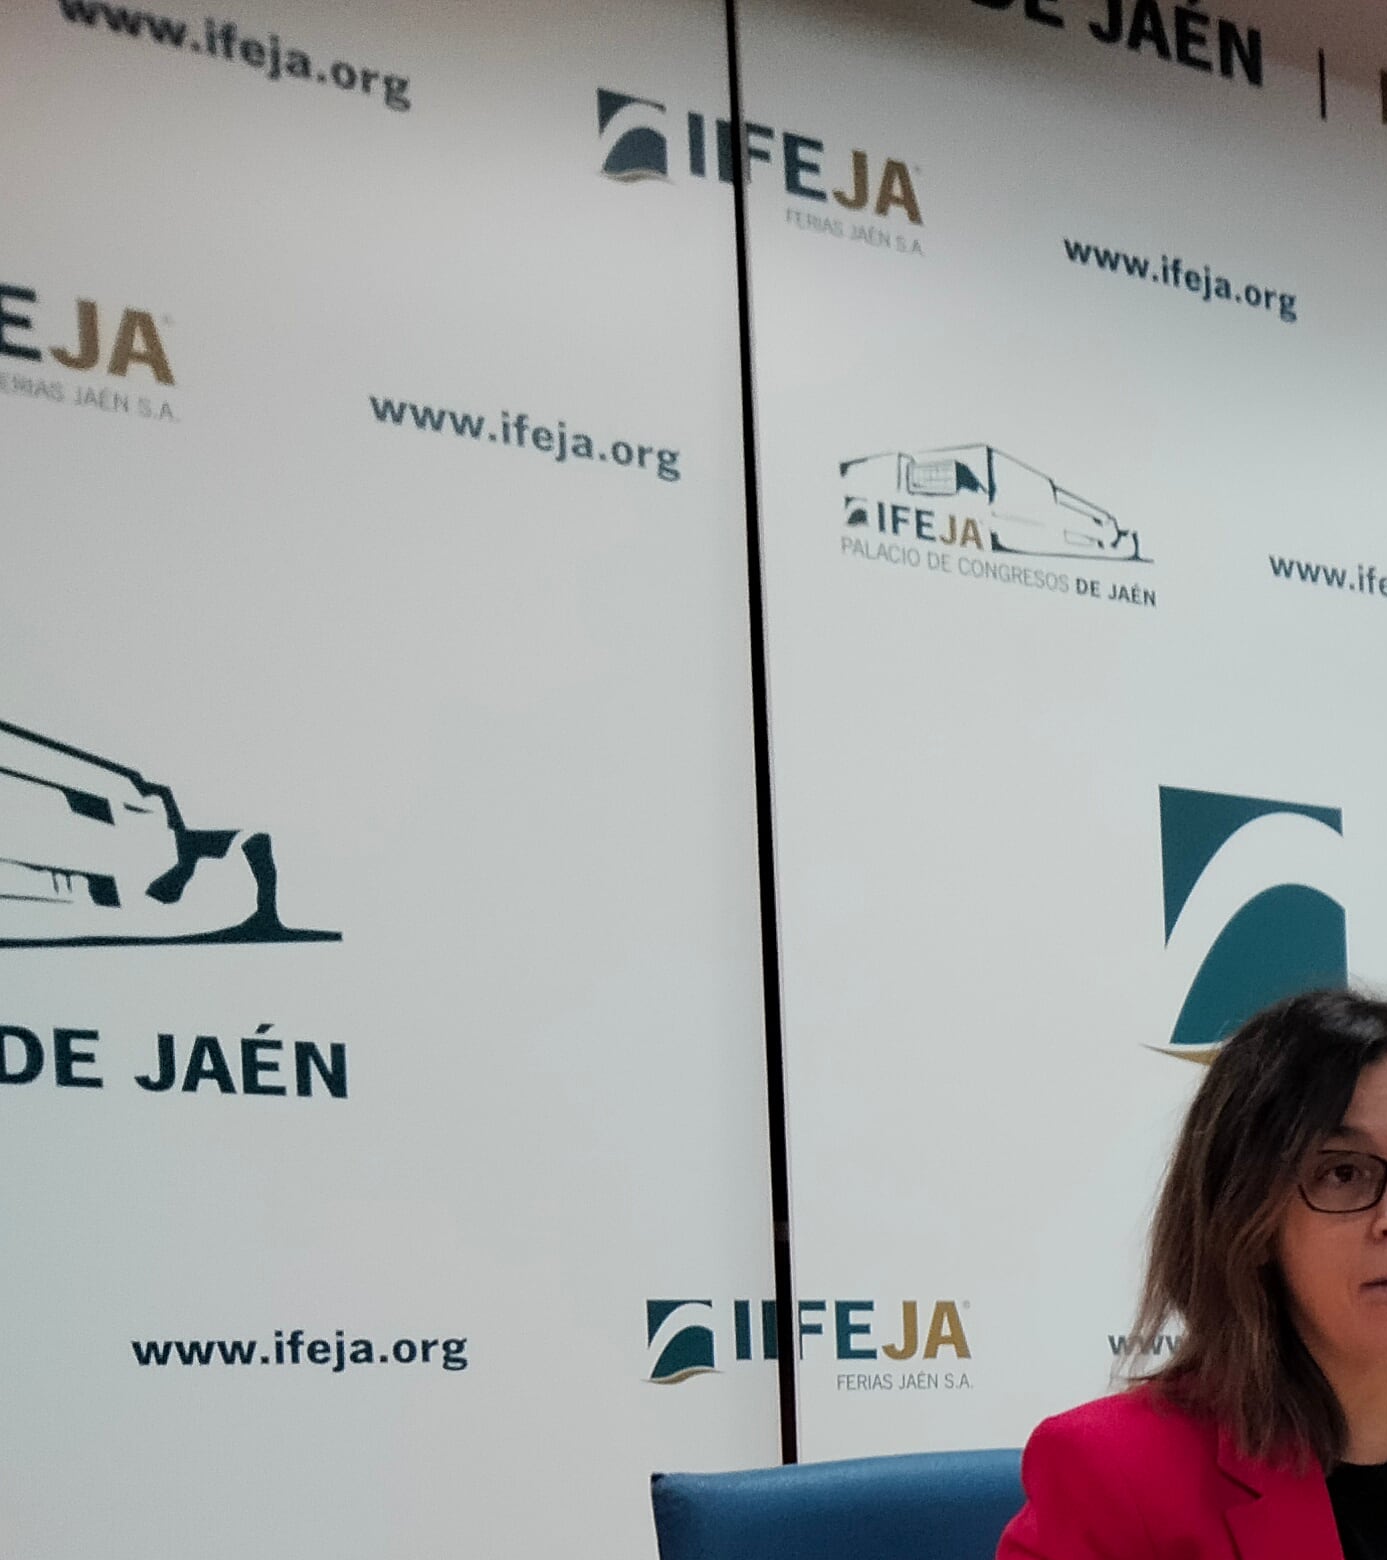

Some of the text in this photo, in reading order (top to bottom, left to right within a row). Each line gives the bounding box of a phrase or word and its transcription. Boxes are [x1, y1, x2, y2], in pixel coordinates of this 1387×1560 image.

[61, 0, 411, 112] www.ifeja.org
[688, 111, 922, 226] IFEJA
[1064, 237, 1298, 323] www.ifeja.org
[369, 394, 681, 482] www.ifeja.org
[877, 501, 984, 551] IFEJA
[841, 535, 1157, 608] PALACIO DE CONGRESOS DE JAÉN
[0, 1023, 348, 1099] DE JAÉN
[131, 1329, 469, 1373] www.ifeja.org
[734, 1300, 972, 1361] IFEJA
[836, 1361, 975, 1392] FERIAS JAÉN S.A.
